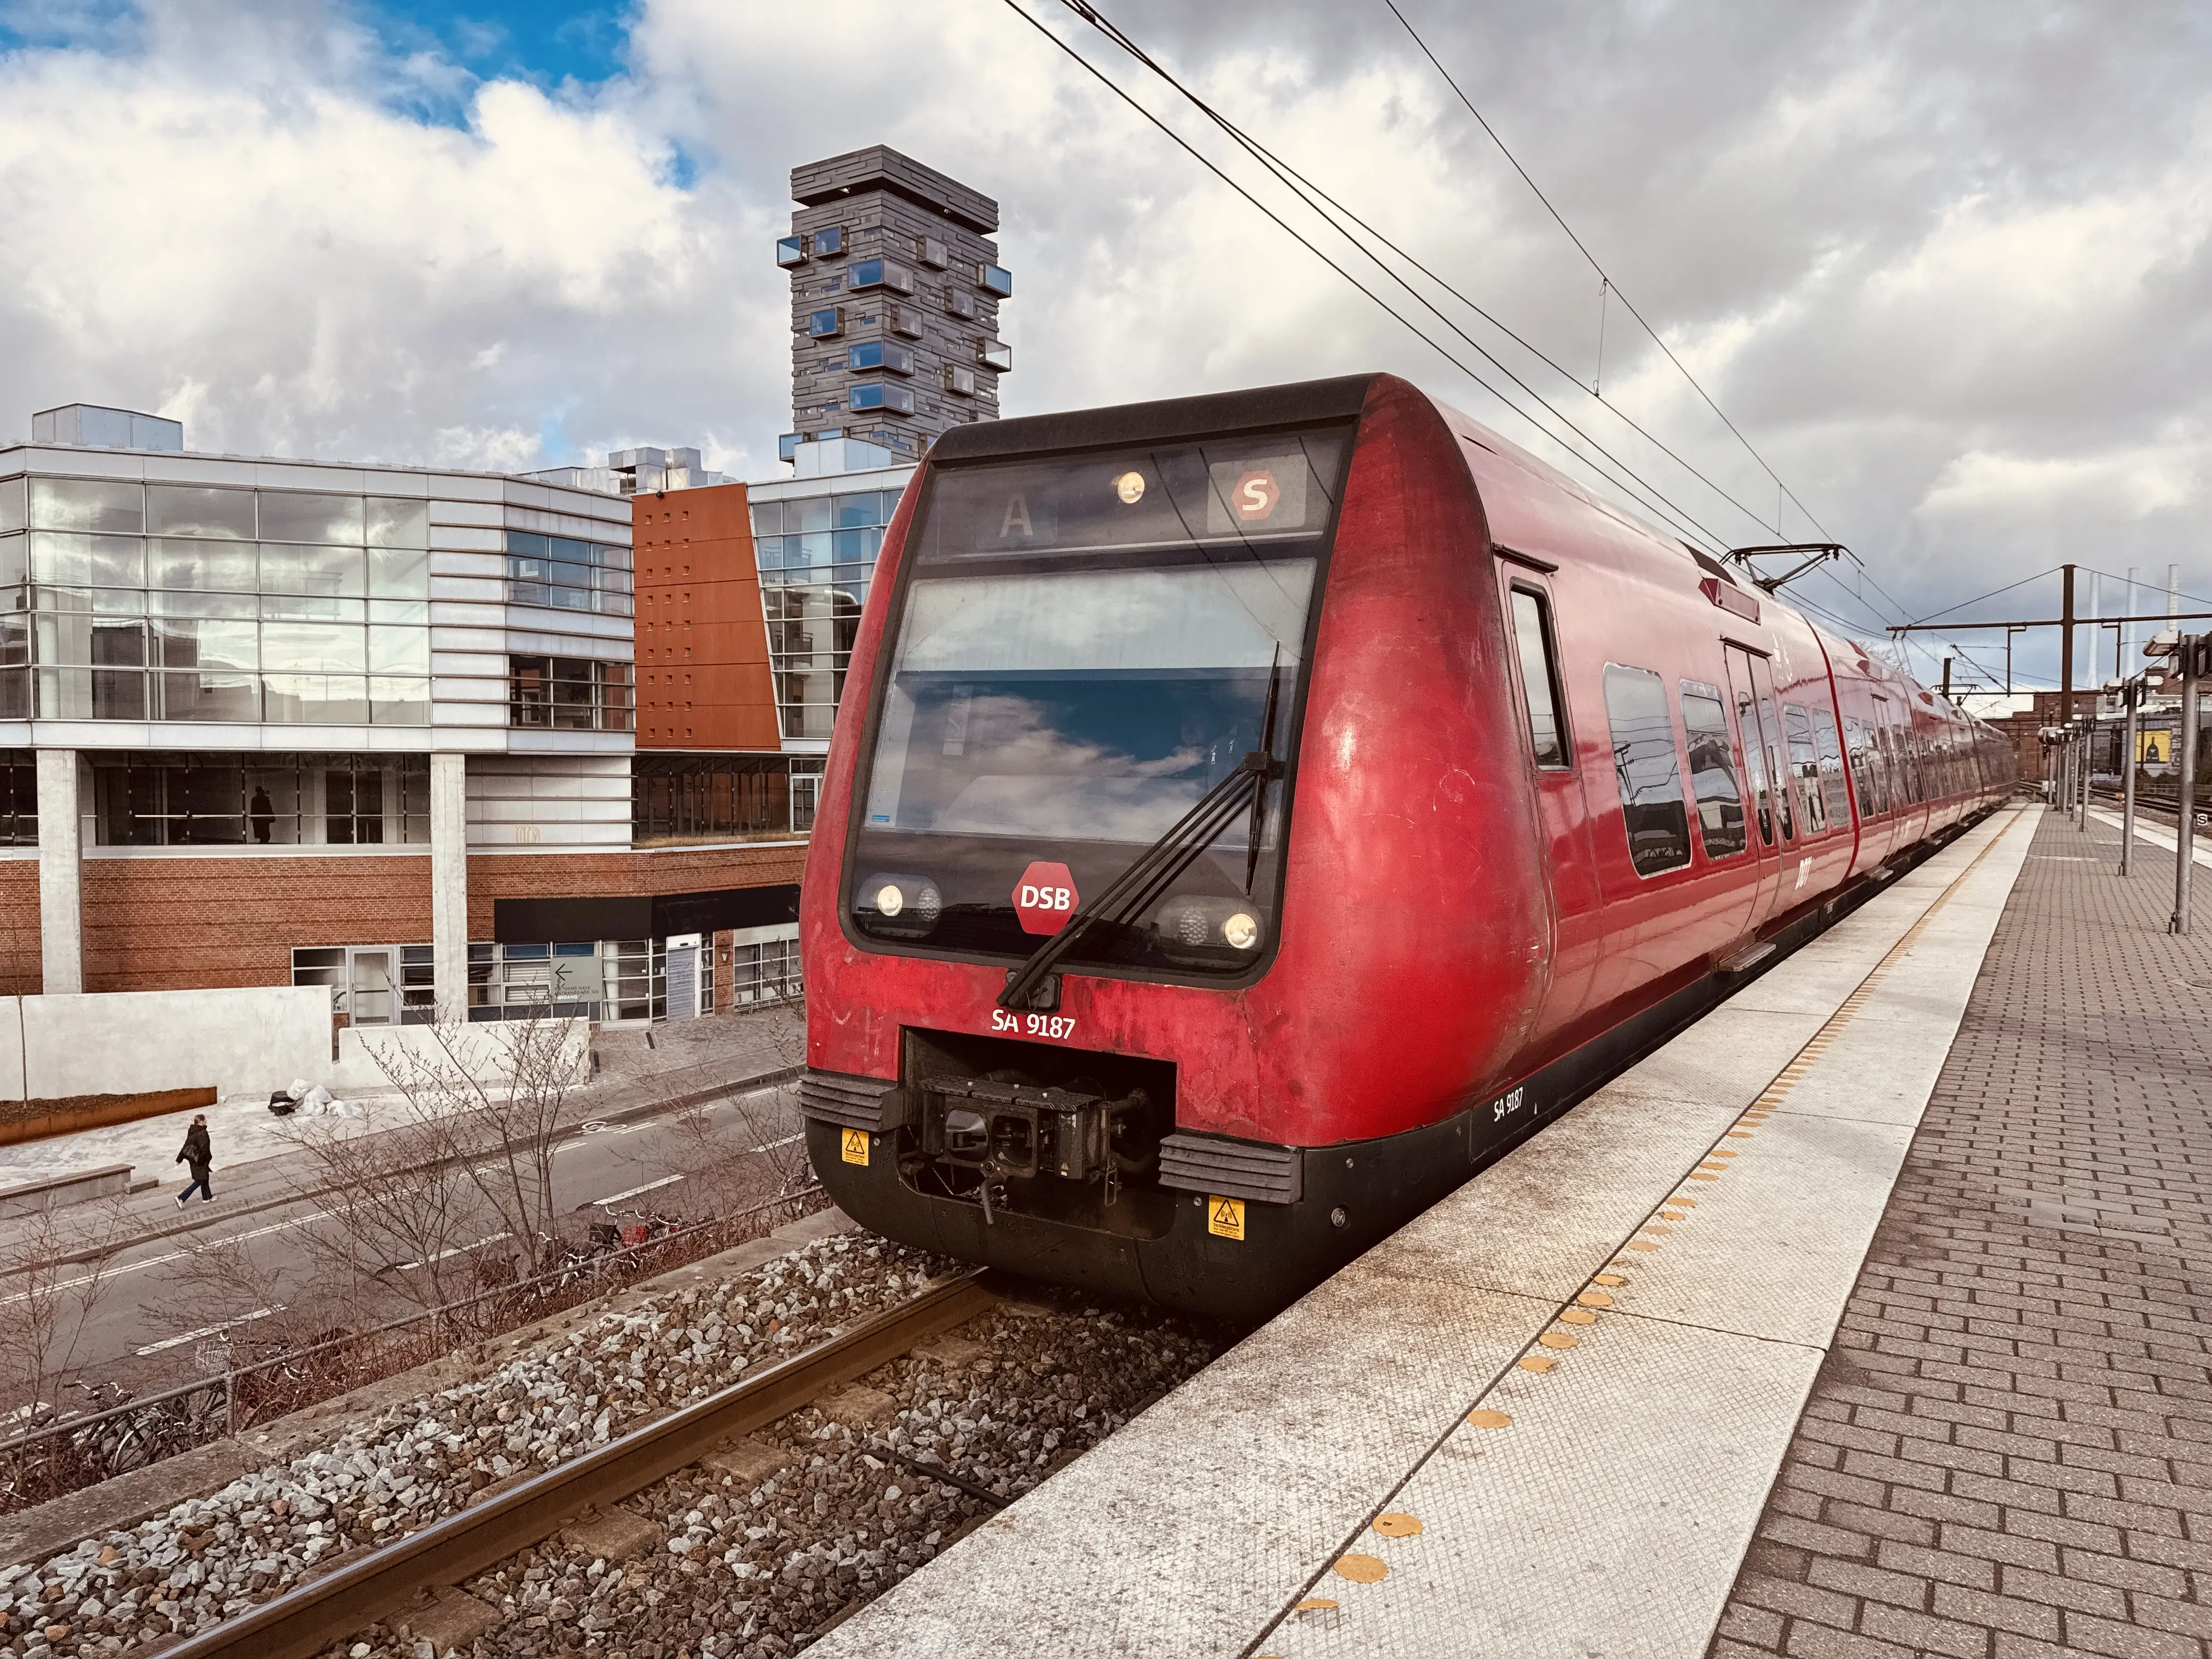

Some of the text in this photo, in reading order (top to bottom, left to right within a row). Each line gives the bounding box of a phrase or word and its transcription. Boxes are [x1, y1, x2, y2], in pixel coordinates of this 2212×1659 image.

[1242, 478, 1268, 511] S
[999, 492, 1033, 538] A
[2198, 815, 2207, 824] S
[1021, 885, 1070, 910] DSB
[991, 1009, 1076, 1040] SA 9187
[1494, 1087, 1523, 1122] SA 9187
